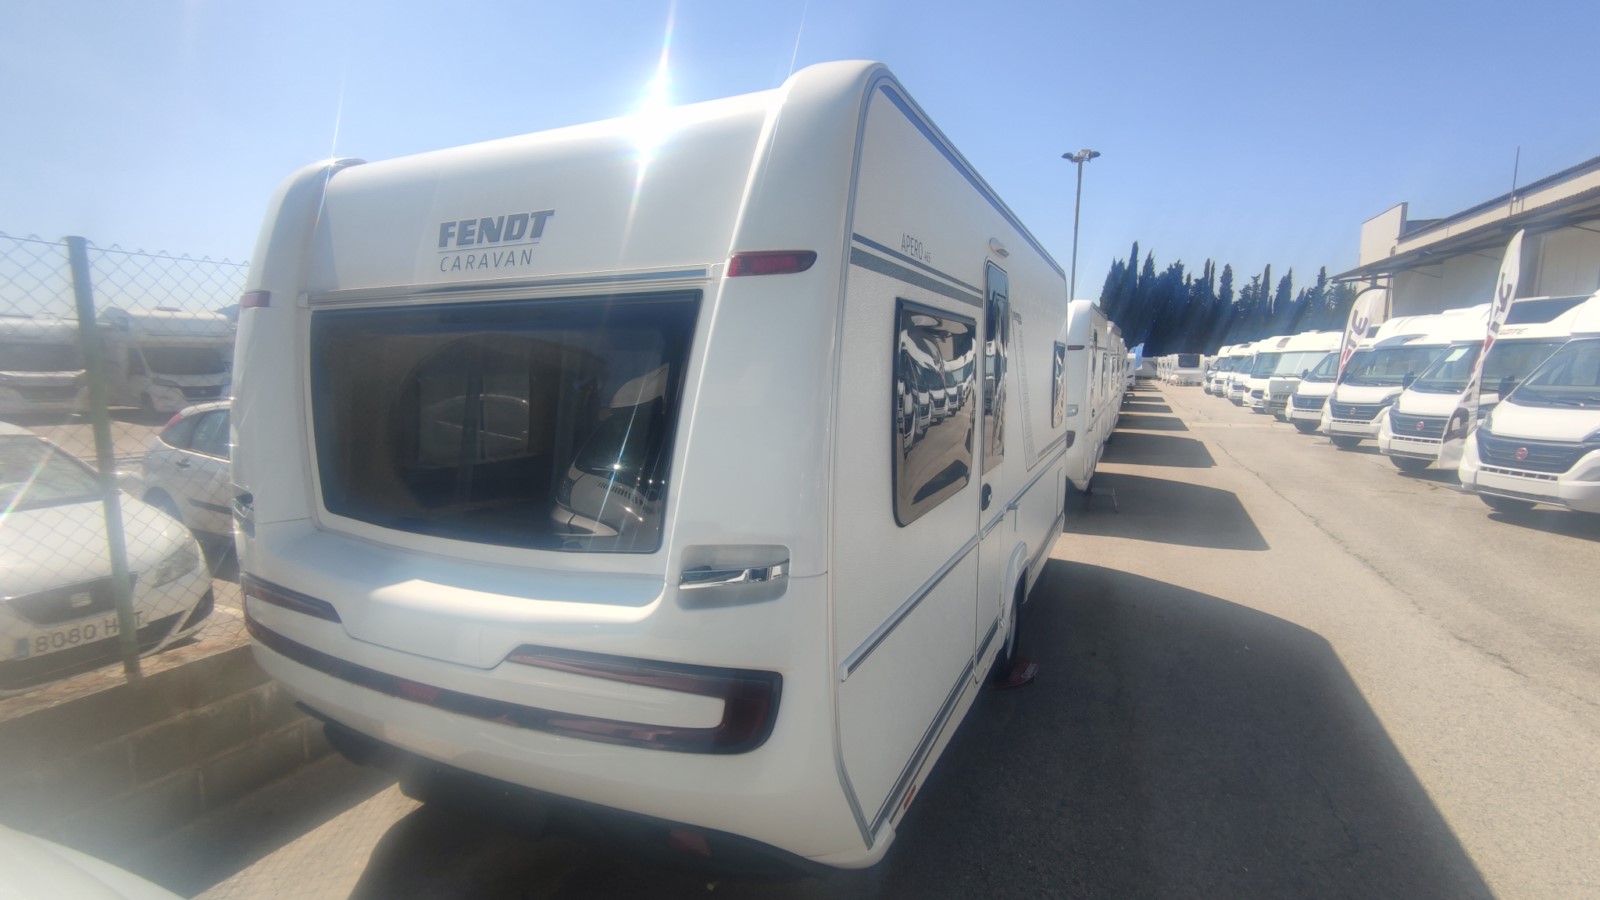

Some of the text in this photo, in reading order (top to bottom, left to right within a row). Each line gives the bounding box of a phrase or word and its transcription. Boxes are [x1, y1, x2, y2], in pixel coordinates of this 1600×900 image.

[438, 209, 555, 248] FENDT
[440, 248, 533, 272] CARAVAN
[901, 232, 924, 260] APERO
[35, 610, 143, 654] 8080 HT
